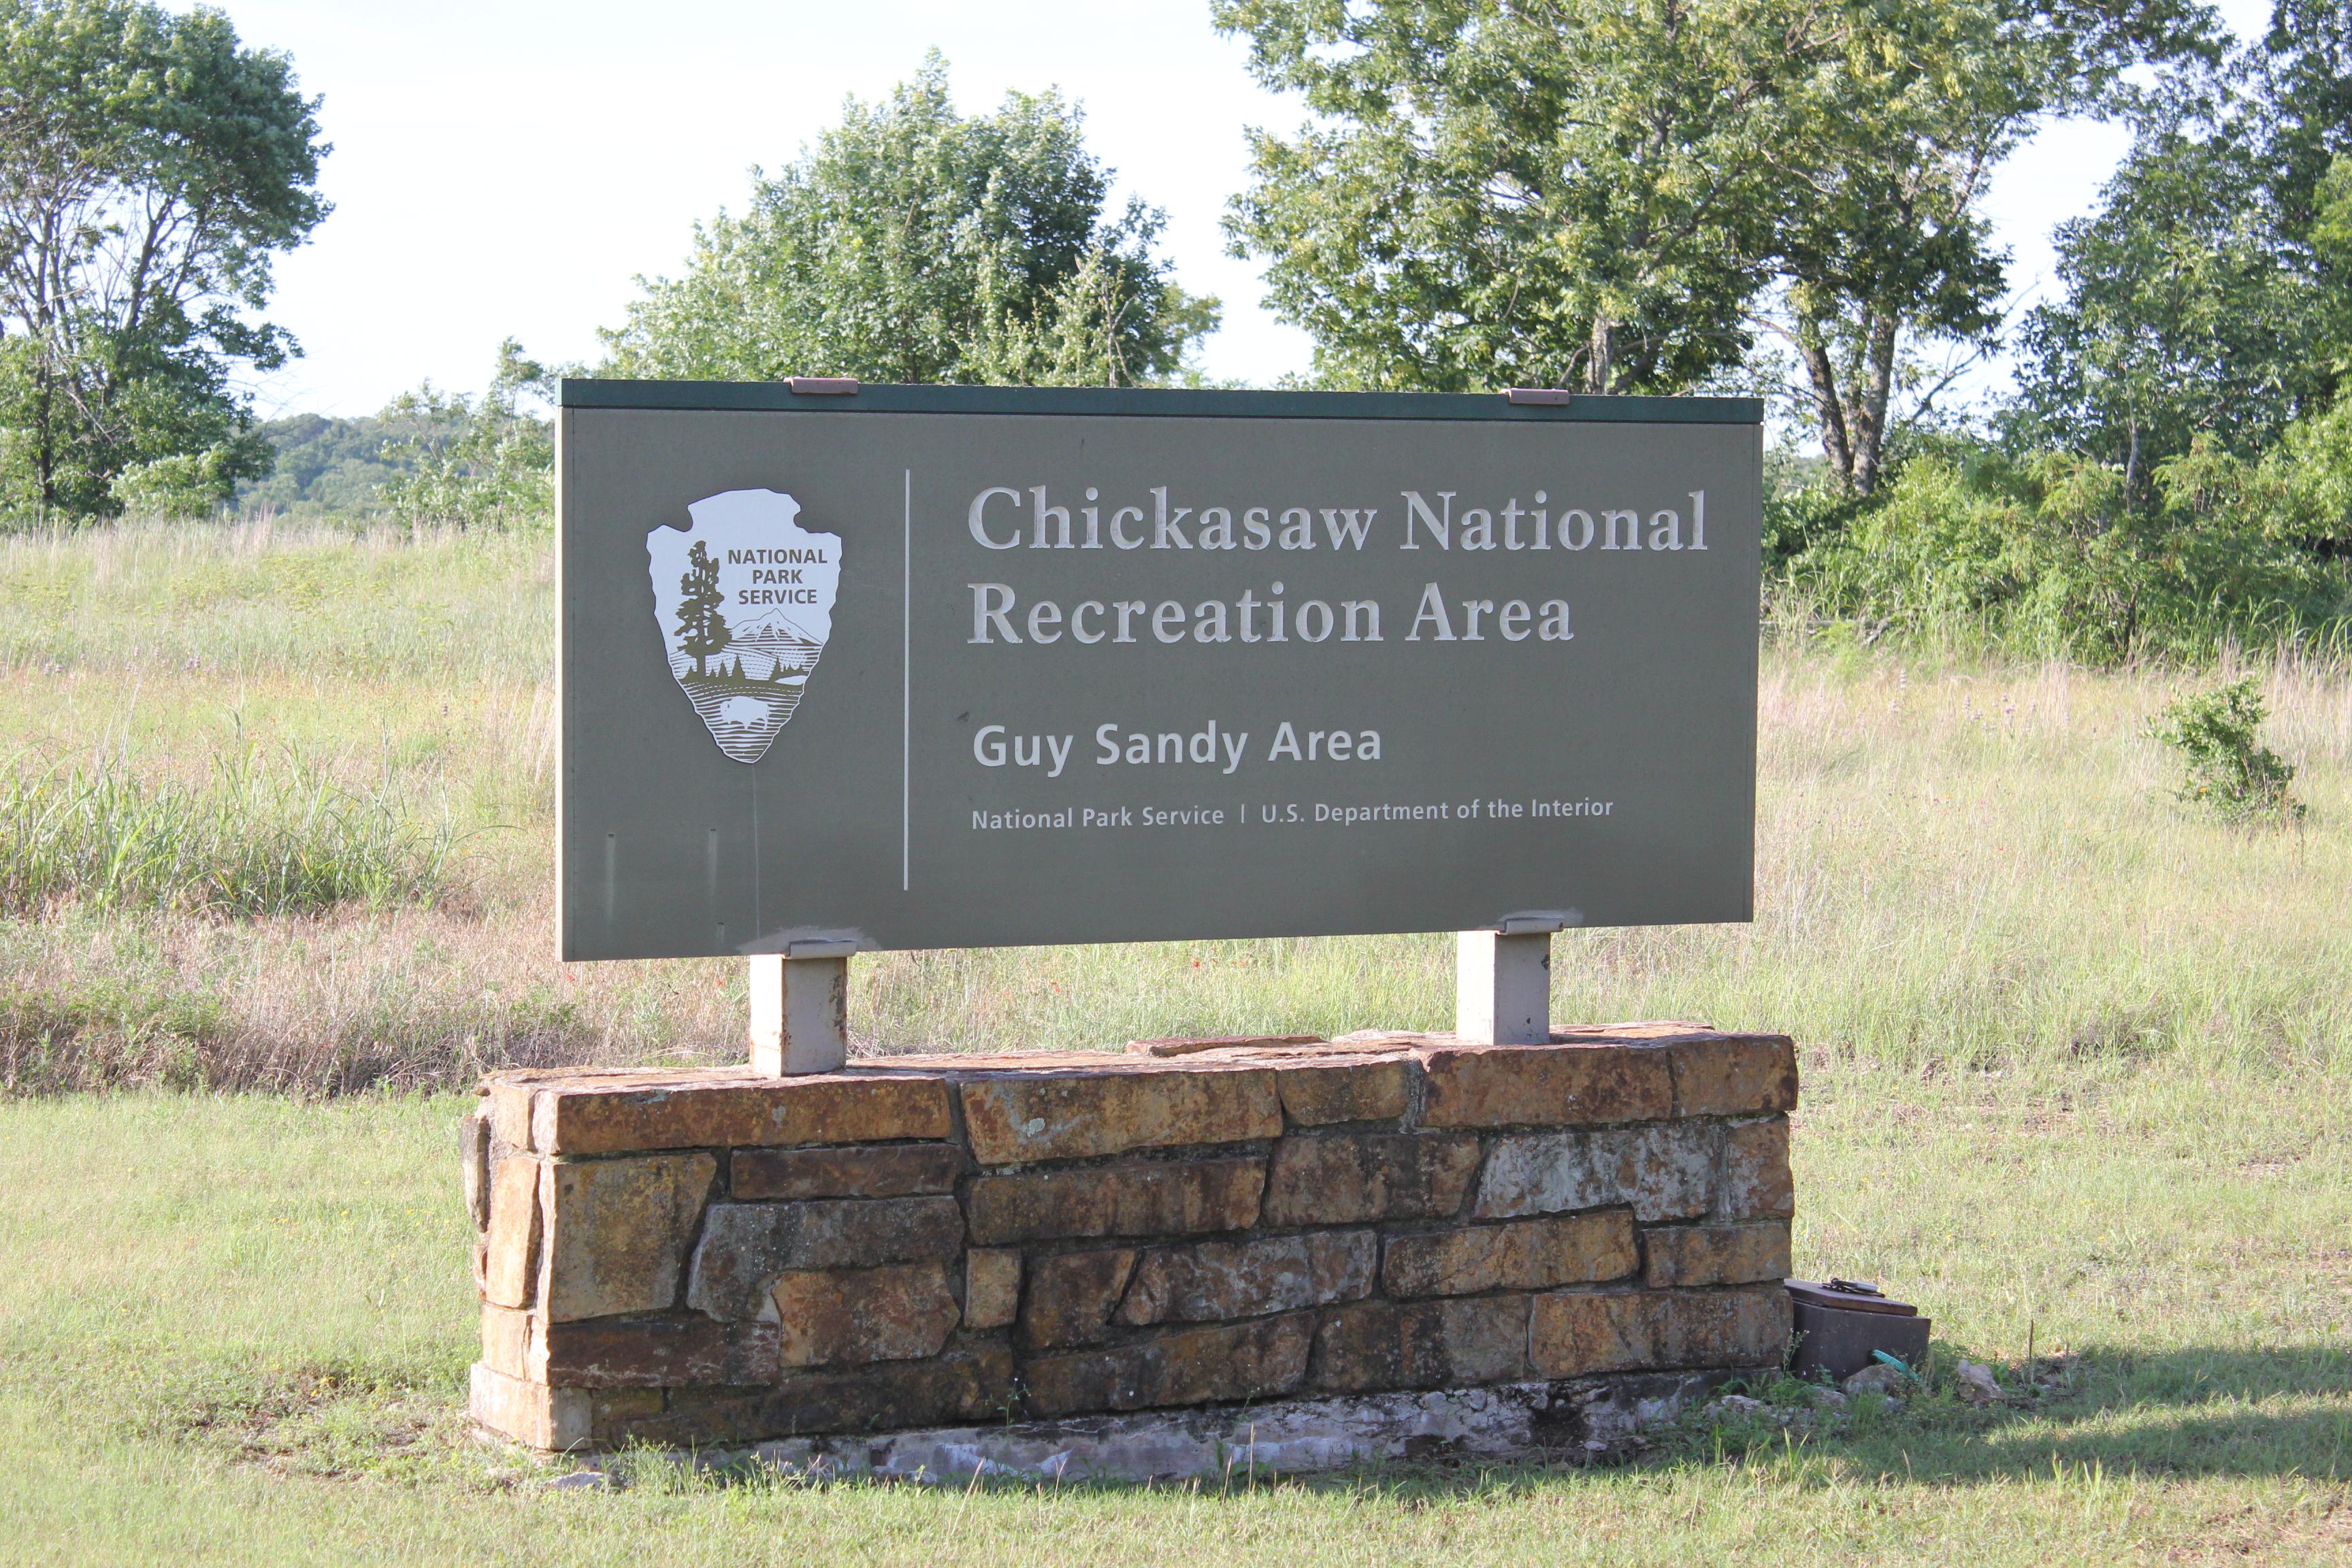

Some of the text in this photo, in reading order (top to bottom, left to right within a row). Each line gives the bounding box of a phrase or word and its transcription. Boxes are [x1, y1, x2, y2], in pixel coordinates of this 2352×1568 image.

[968, 485, 1708, 551] Chickasaw National
[729, 549, 827, 564] NATIONAL
[753, 570, 802, 584] PARK
[739, 589, 817, 604] SERVICE
[968, 582, 1574, 644] Recreation Area
[974, 720, 1379, 777] Guy Sandy Area
[973, 798, 1613, 829] National Park Service U.S. Department of the Interior
